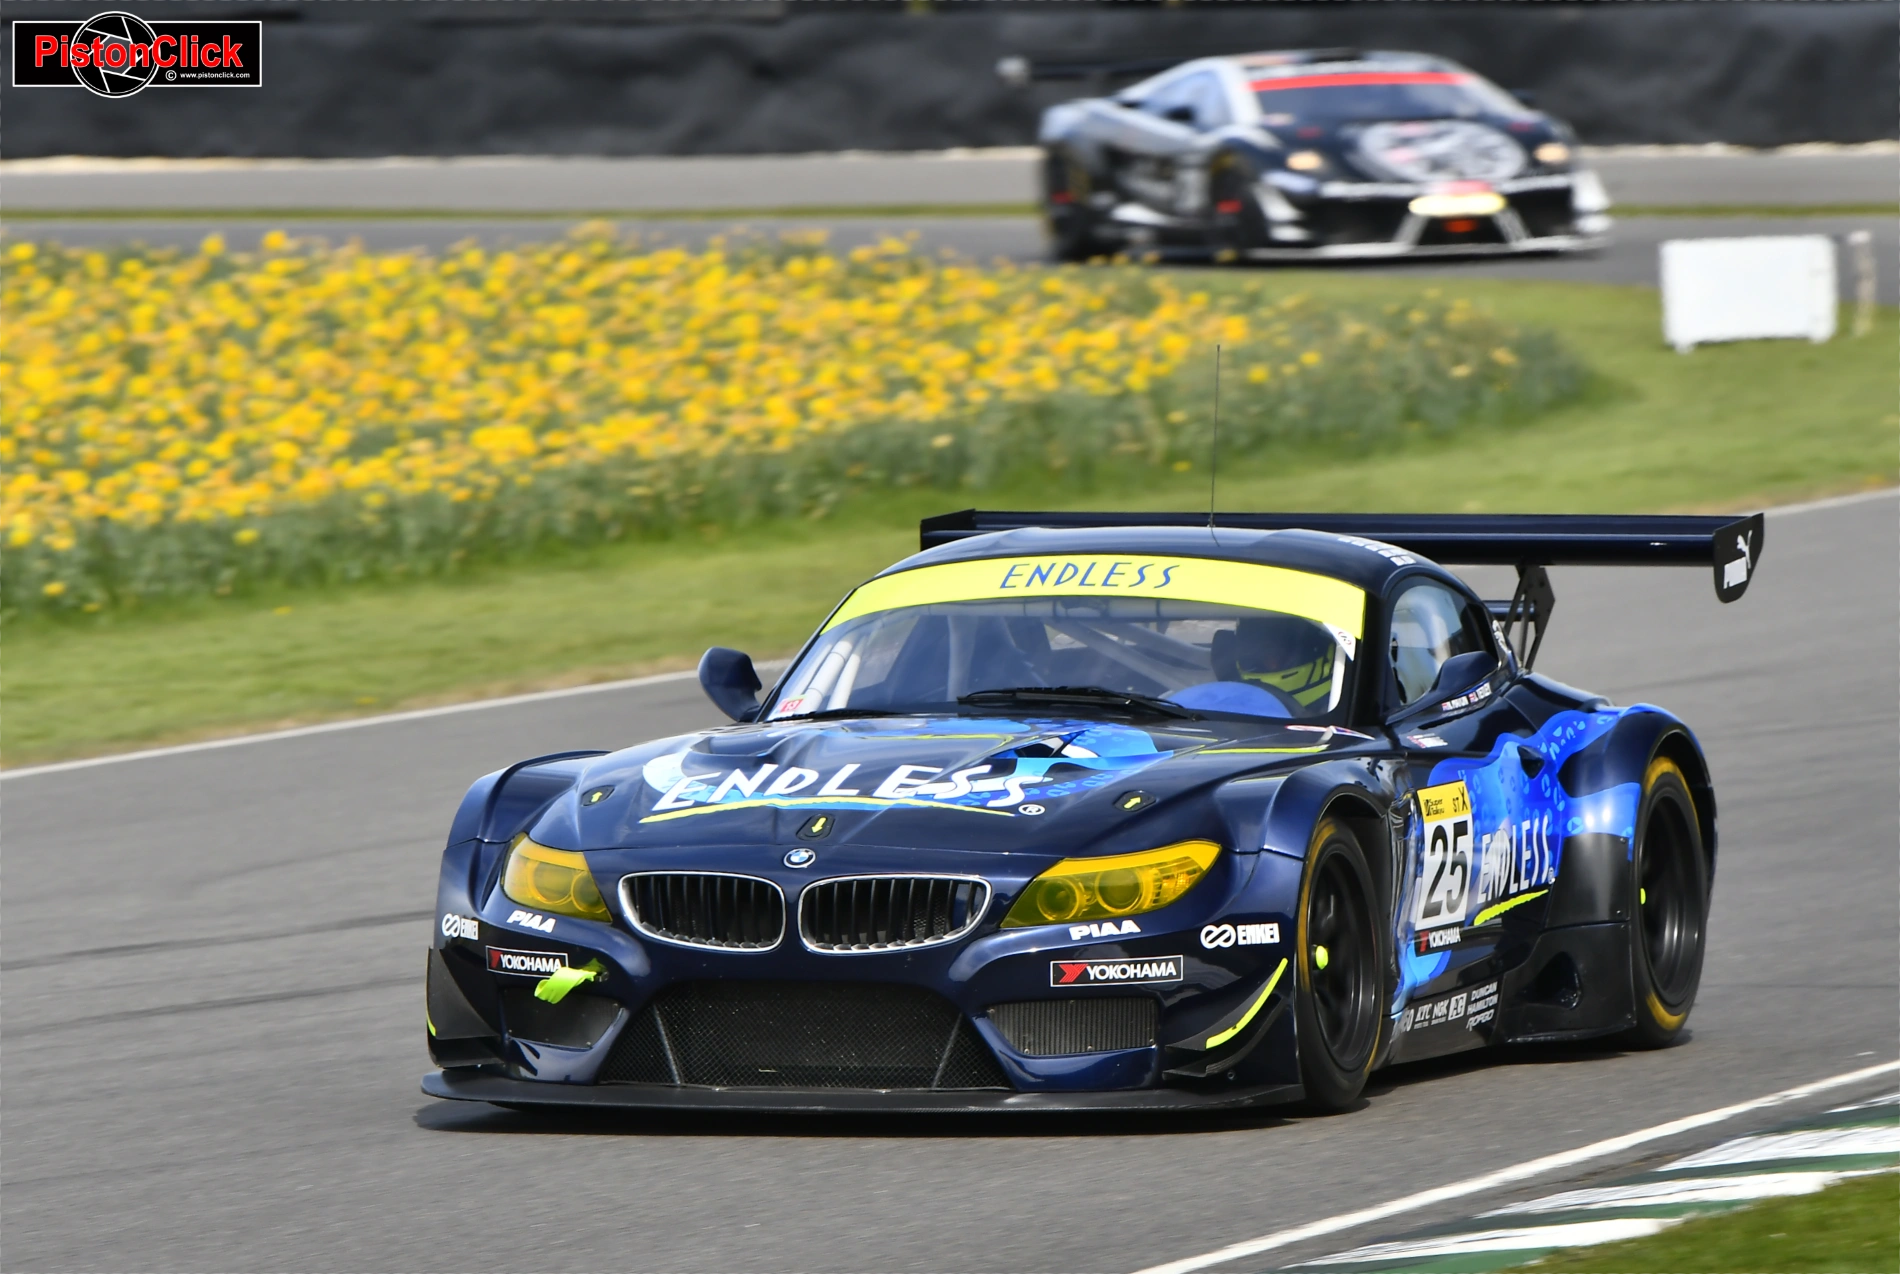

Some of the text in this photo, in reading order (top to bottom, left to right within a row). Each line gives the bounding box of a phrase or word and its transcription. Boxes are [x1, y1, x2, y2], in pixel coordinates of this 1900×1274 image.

[999, 562, 1180, 589] ENDLESS
[651, 763, 1053, 811] ENDLESS
[1422, 820, 1468, 920] 25
[1477, 815, 1549, 904] ENDLESS
[507, 910, 557, 933] PIAA
[1069, 919, 1141, 941] PIAA
[1237, 922, 1280, 946] ENKEI
[1428, 926, 1461, 949] YOKOHAMA
[500, 953, 562, 973] YOKOHAMA
[1086, 961, 1177, 981] YOKOHAMA
[1470, 982, 1498, 1001] DUNCAN
[1432, 999, 1449, 1019] NGK
[1467, 994, 1498, 1015] HAMILTON
